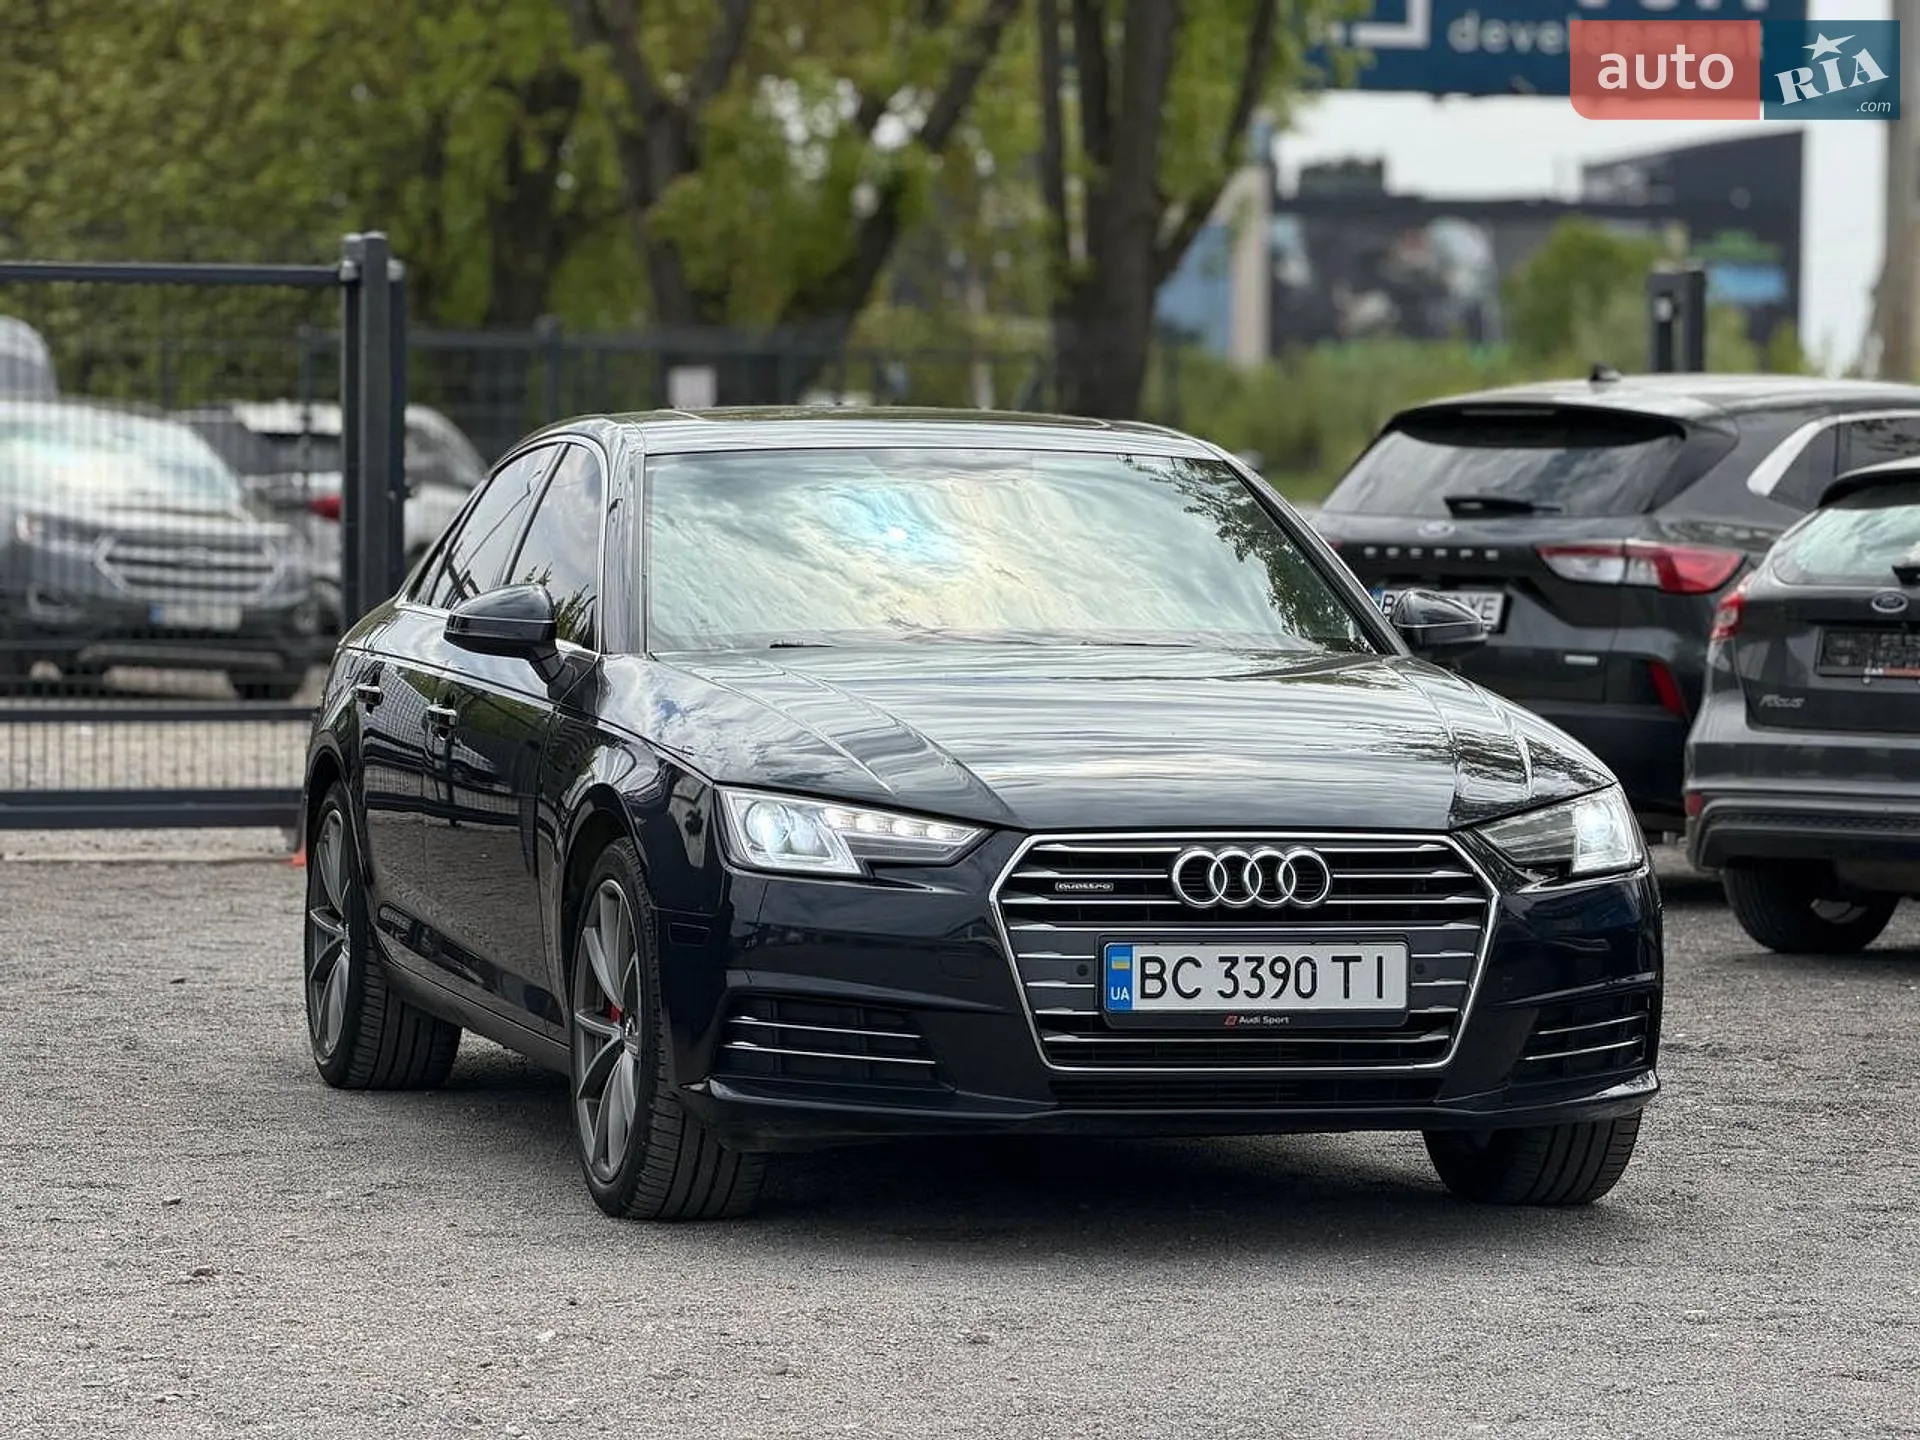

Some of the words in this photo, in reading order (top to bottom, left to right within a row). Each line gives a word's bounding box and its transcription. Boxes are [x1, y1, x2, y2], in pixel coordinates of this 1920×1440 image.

[1139, 956, 1202, 999] BC
[1216, 956, 1318, 999] 3390
[1331, 956, 1384, 999] TI
[1110, 986, 1130, 1001] UA
[1239, 1015, 1261, 1024] Audi
[1263, 1015, 1290, 1025] Sport
